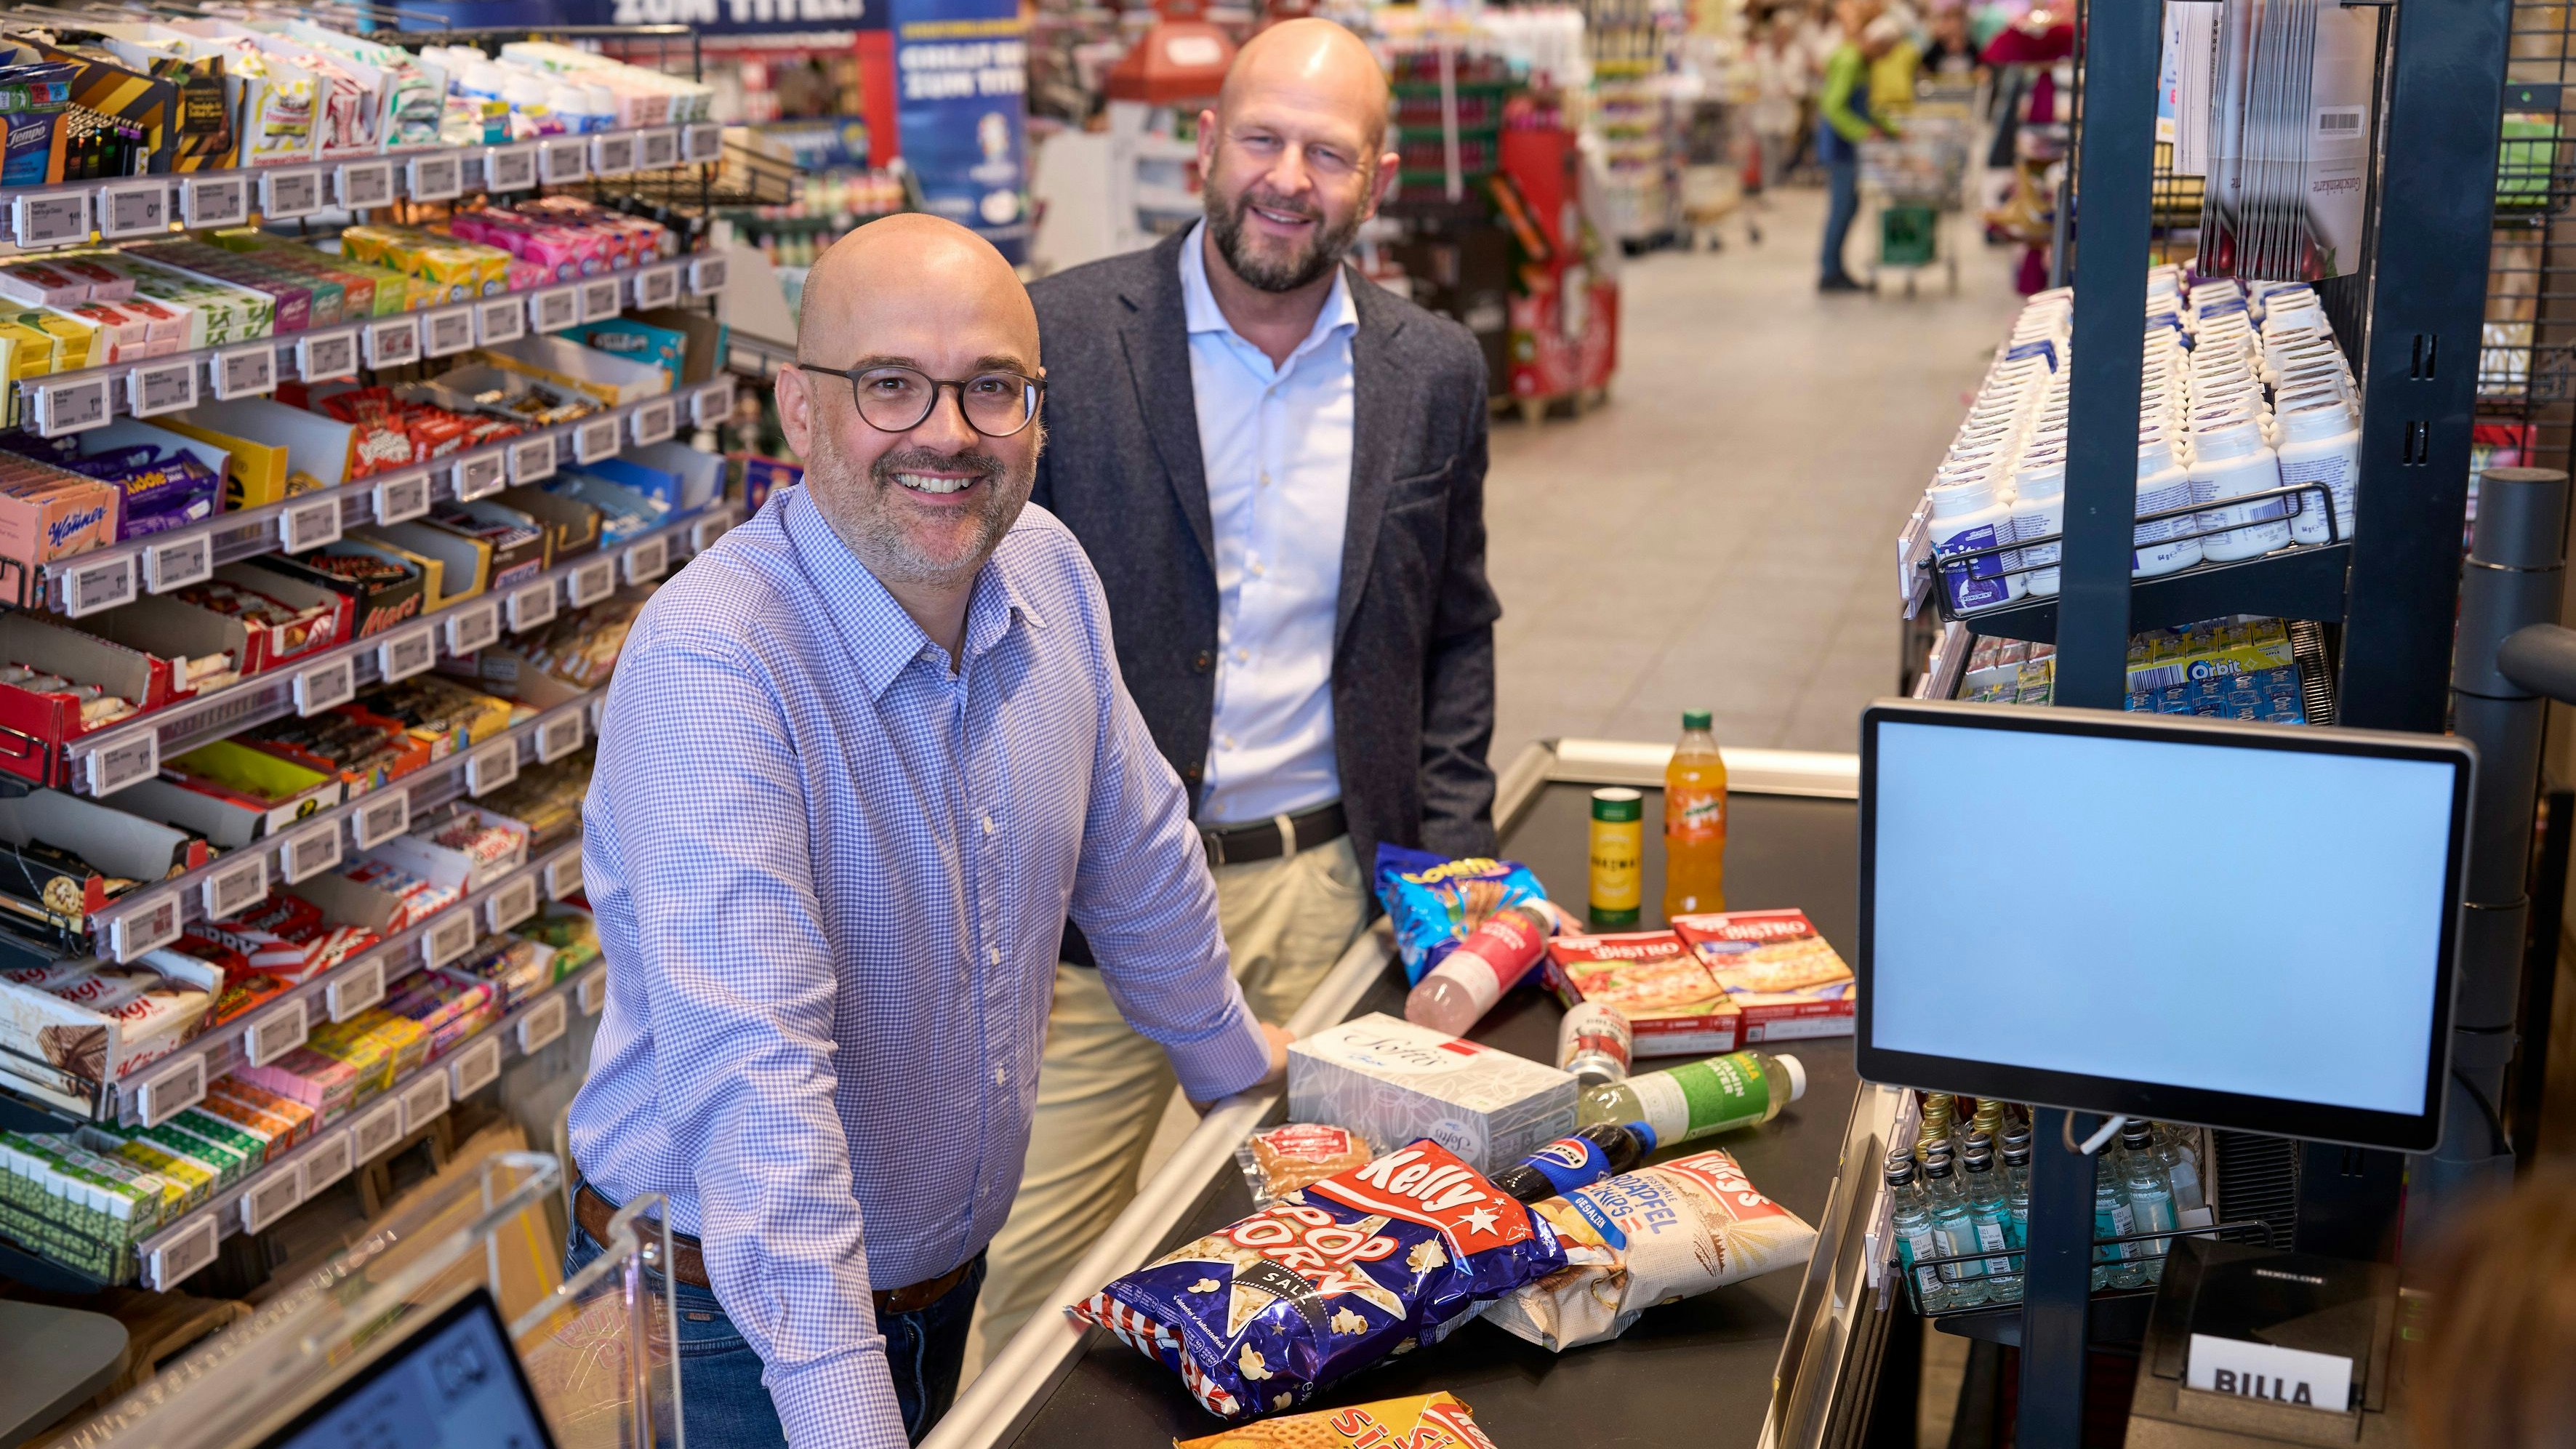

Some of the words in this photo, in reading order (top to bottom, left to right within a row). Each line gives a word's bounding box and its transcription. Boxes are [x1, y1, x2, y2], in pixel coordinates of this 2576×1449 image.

[7, 120, 46, 148] Tempo
[2313, 177, 2361, 196] Gutscheinkarte
[48, 505, 107, 547] Manner
[1944, 565, 1981, 574] PROFESSIAL
[359, 592, 420, 639] Mars
[2191, 658, 2242, 681] Orbit
[1544, 1144, 1583, 1165] EPSI
[1355, 1150, 1488, 1213] Kelly
[1645, 1175, 1678, 1203] RUSTIKALE
[1575, 1196, 1607, 1229] GESALZEN
[1608, 1173, 1678, 1235] RDÄPFEL
[1269, 1205, 1400, 1268] POP
[1261, 1272, 1312, 1306] SALZ
[1196, 1317, 1227, 1350] ballaststoffreich
[2215, 1368, 2312, 1406] BILLA
[1331, 1408, 1397, 1449] Si
